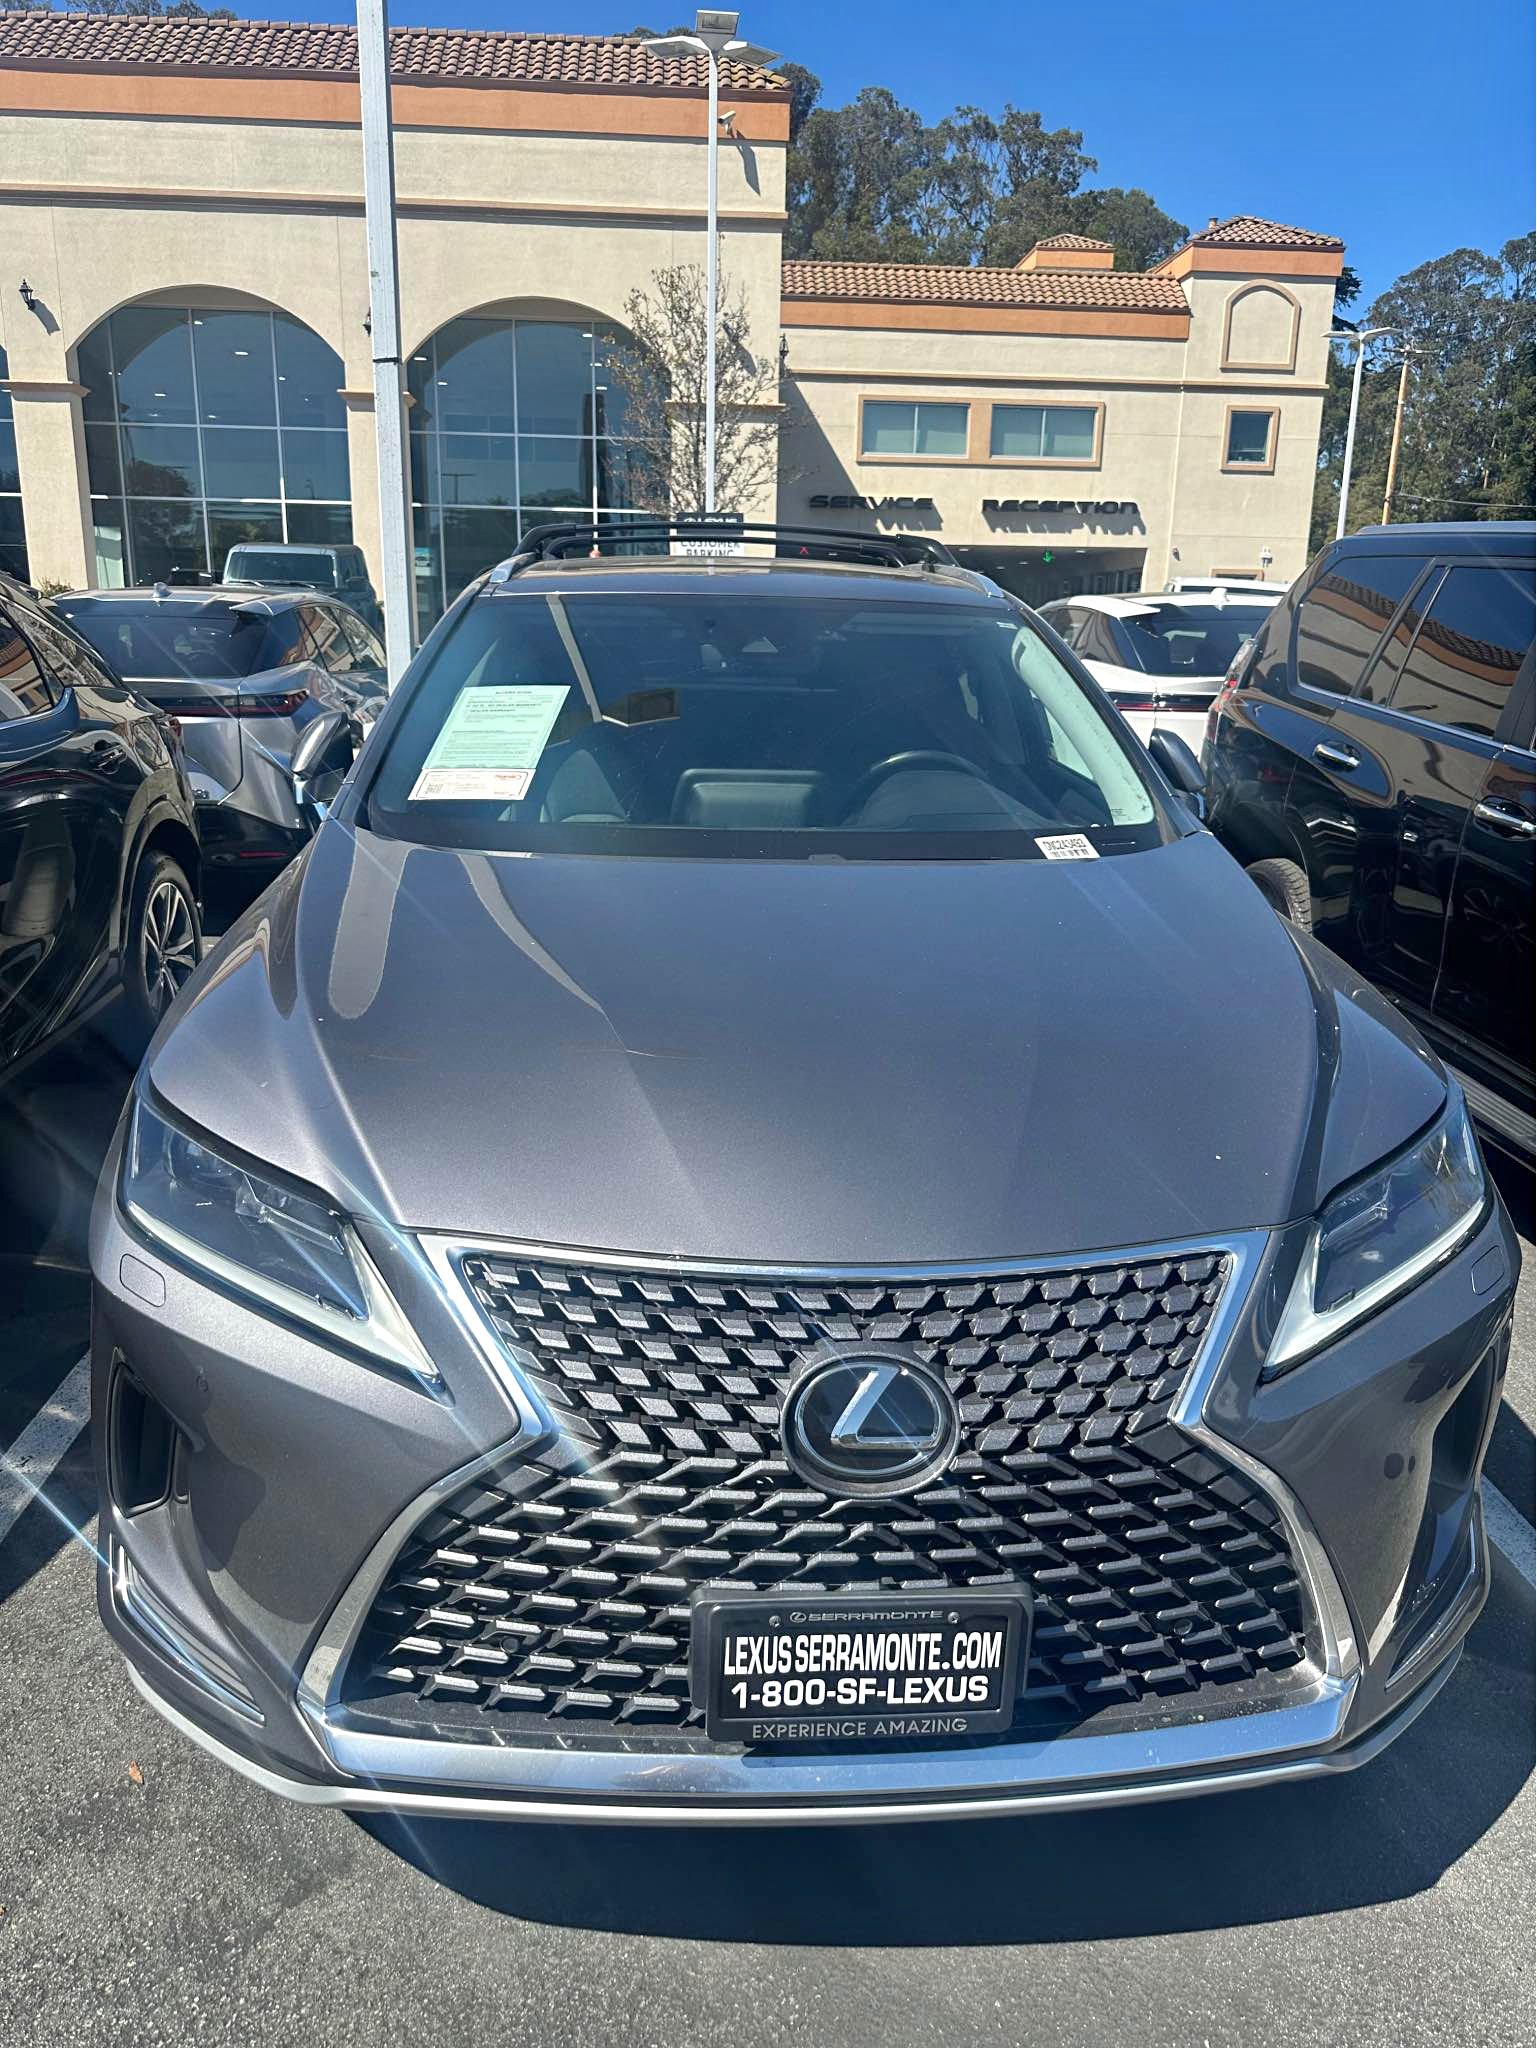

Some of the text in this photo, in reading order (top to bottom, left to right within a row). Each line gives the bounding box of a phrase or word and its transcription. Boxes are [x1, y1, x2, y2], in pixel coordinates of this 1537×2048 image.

[808, 495, 1140, 514] SERVICE RECEPTION
[808, 1610, 944, 1622] SERRAMONTE
[731, 1675, 989, 1709] 1-800-SF-LEXUS
[752, 1717, 968, 1739] EXPERIENCE AMAZING
